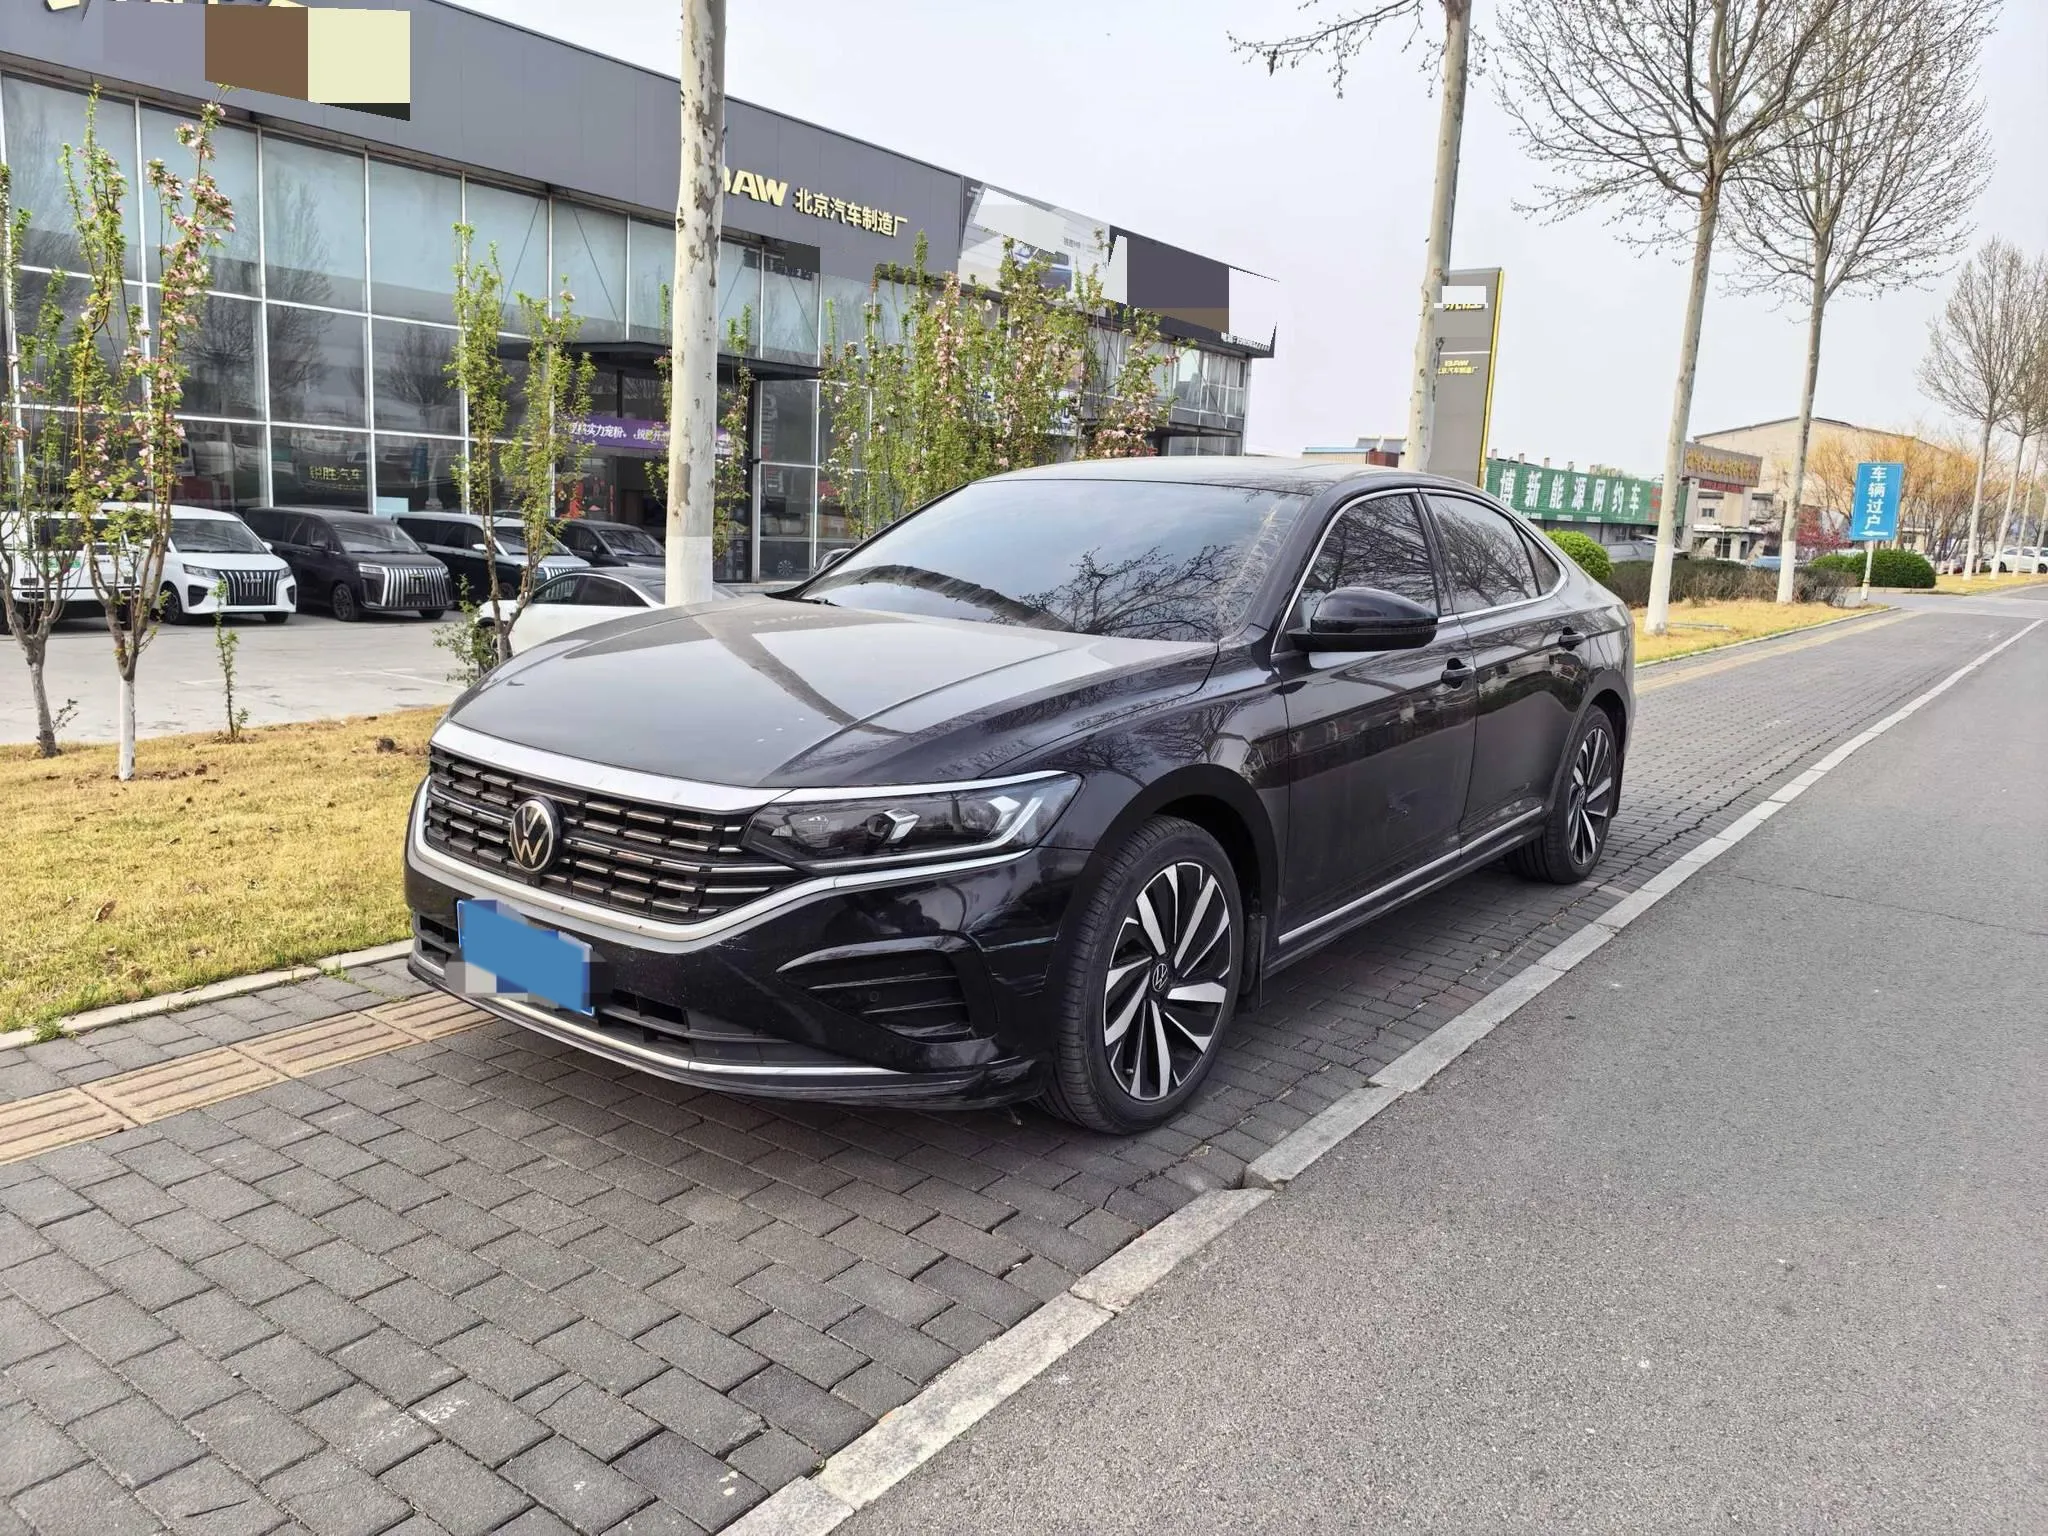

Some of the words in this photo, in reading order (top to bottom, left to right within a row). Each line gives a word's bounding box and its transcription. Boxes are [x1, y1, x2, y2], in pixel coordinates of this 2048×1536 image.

[794, 187, 908, 237] 北京汽车制造厂
[1865, 466, 1887, 530] 车辆过户
